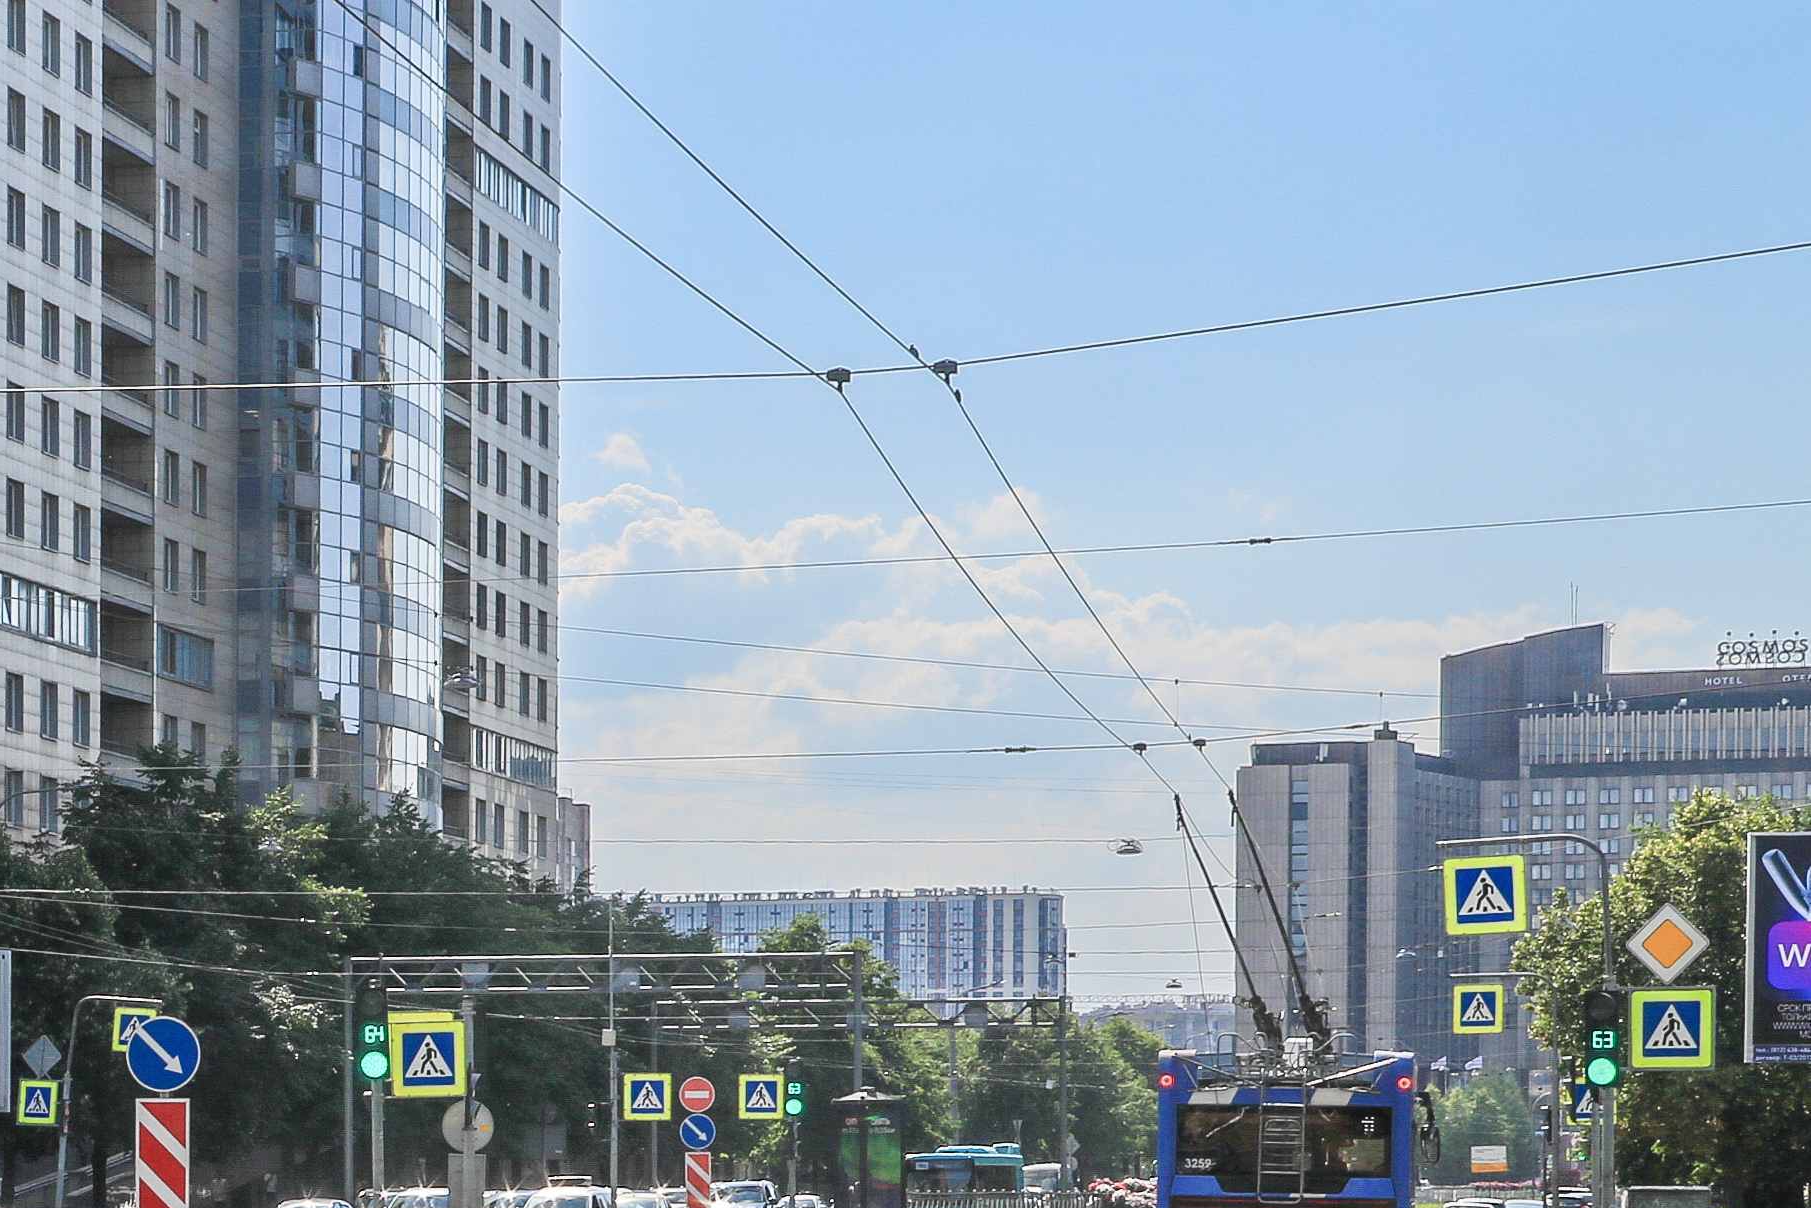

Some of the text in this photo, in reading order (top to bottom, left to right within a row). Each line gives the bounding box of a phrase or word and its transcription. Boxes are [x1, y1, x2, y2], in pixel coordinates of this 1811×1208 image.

[1717, 639, 1808, 655] COSMOS
[1704, 676, 1743, 686] HOTEL
[364, 1025, 384, 1043] 64
[1593, 1031, 1614, 1048] 63
